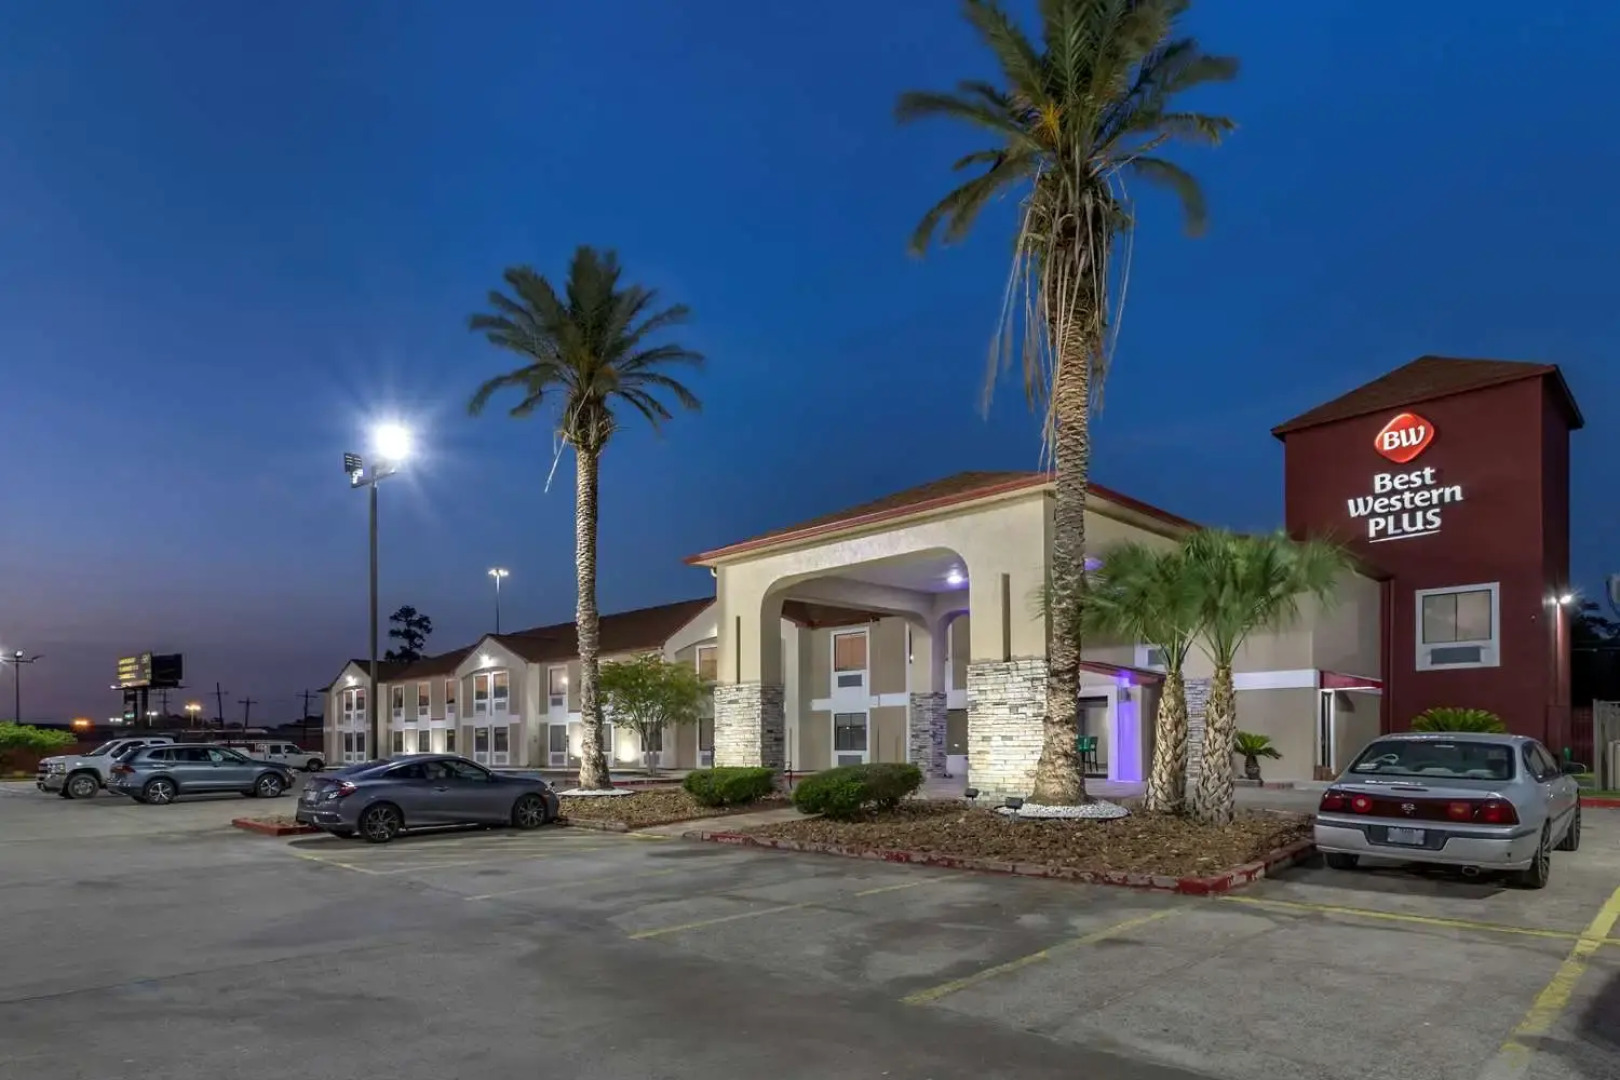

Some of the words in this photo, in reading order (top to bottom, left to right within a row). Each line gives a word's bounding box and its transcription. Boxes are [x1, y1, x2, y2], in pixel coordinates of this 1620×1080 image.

[1383, 426, 1425, 450] BW
[1374, 467, 1436, 494] Best
[1347, 485, 1463, 518] Western
[1368, 509, 1442, 538] PLUS
